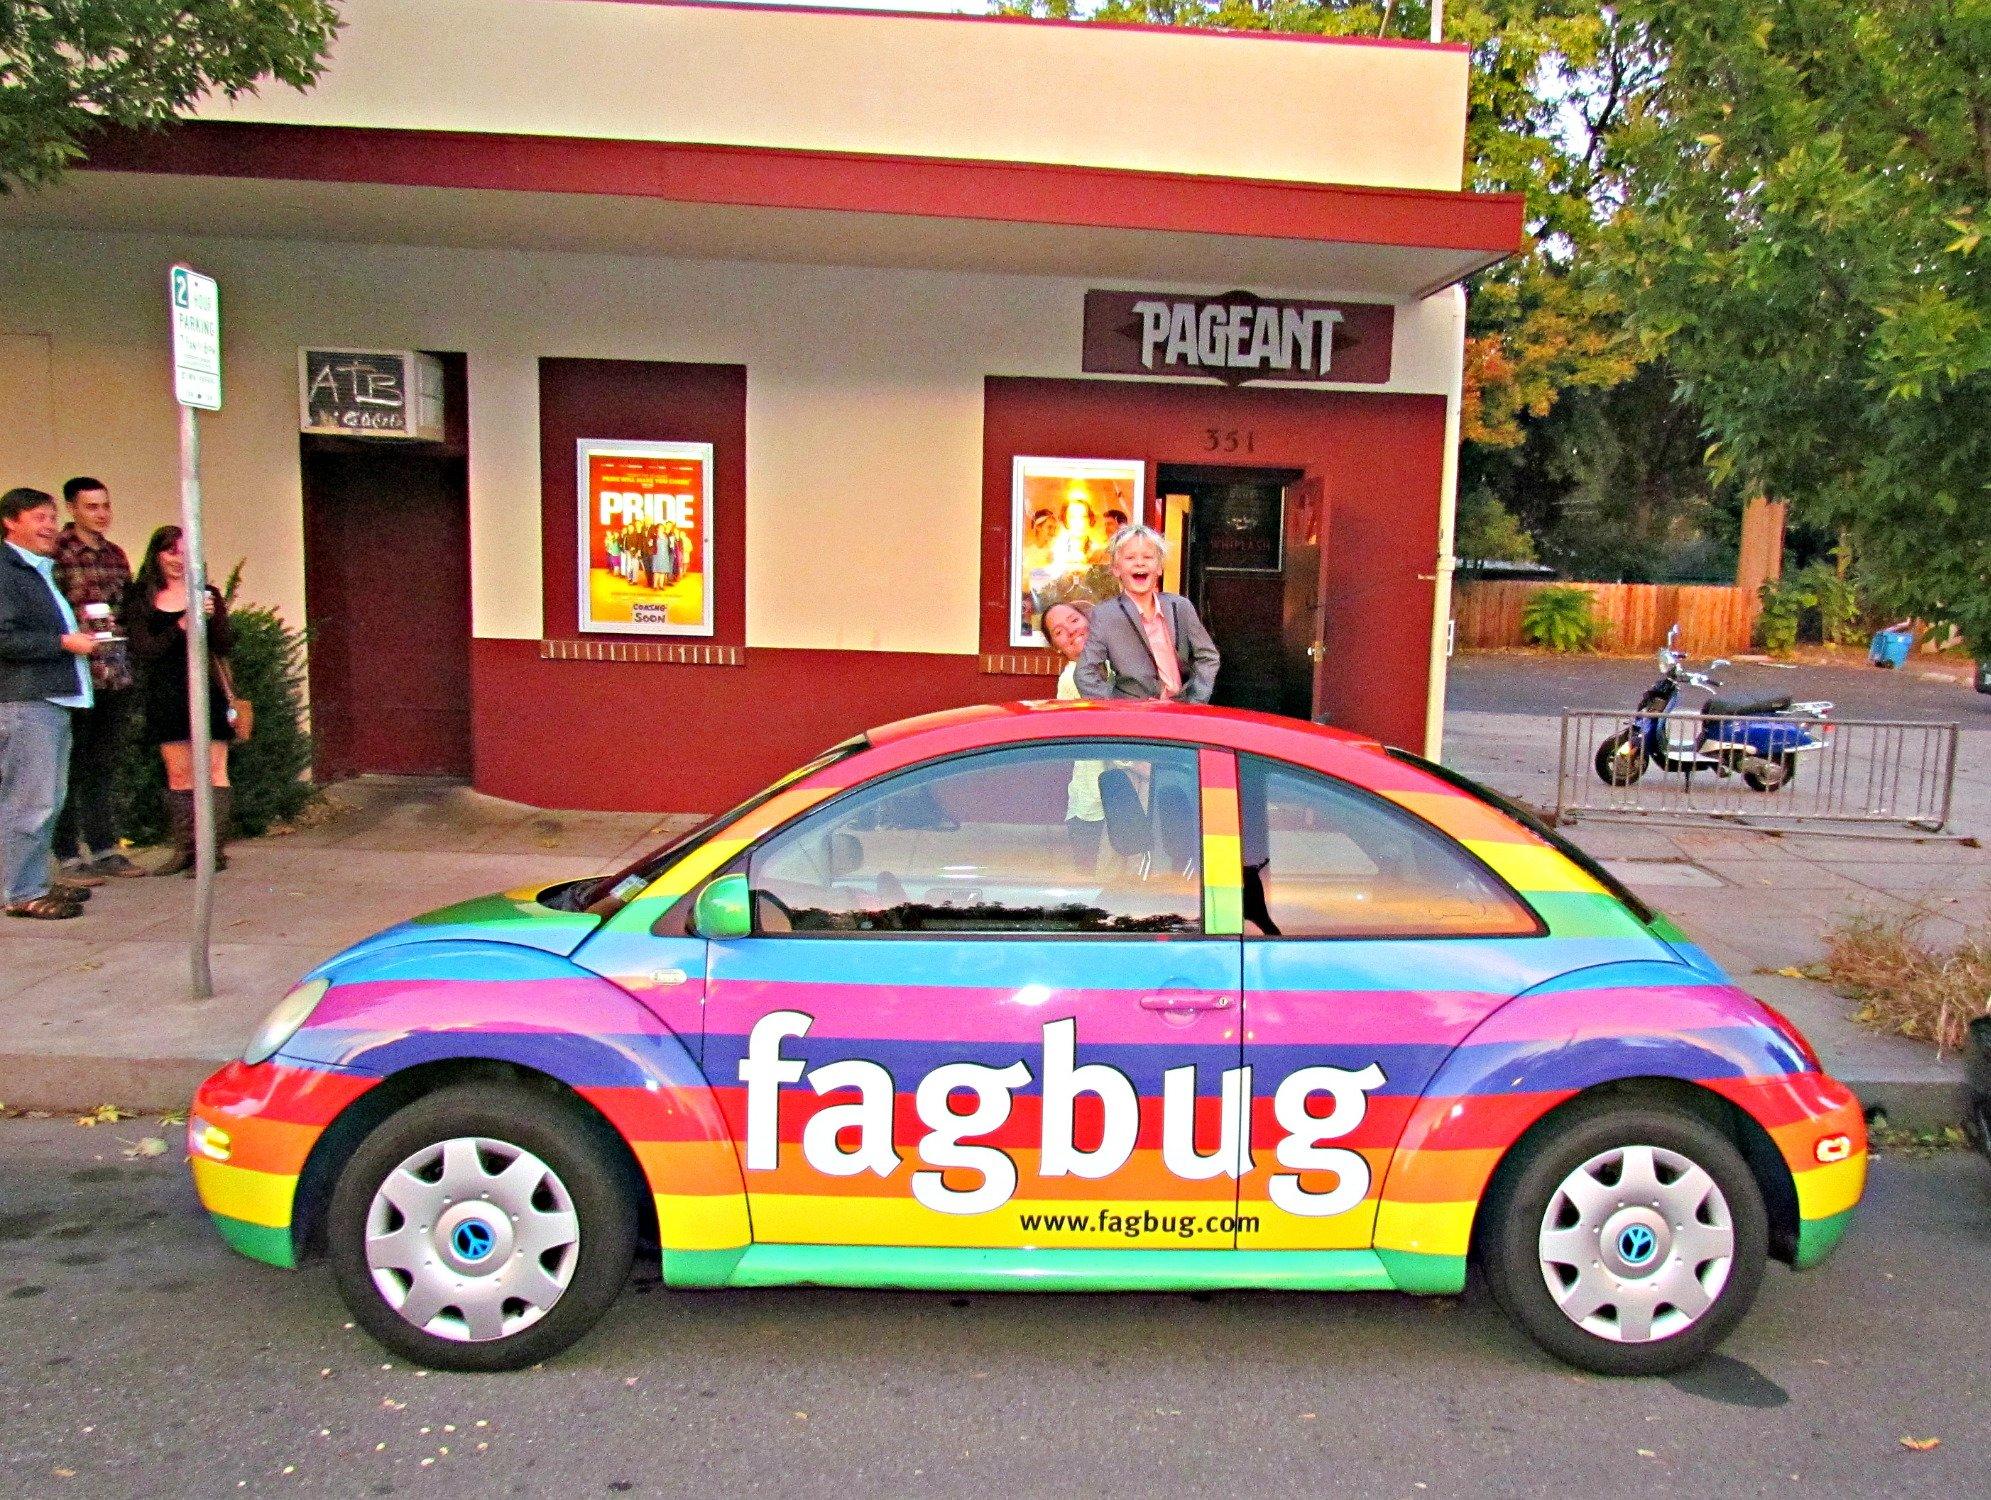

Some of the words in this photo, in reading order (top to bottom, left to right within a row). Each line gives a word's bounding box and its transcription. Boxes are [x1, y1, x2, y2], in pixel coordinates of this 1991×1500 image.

[176, 274, 187, 305] 2
[179, 313, 215, 336] PARKING
[1132, 300, 1344, 376] PAGEANT
[1206, 429, 1255, 453] 351
[600, 491, 694, 528] PRIDE
[634, 612, 666, 624] SOON
[739, 1009, 1387, 1216] fagbug
[1020, 1208, 1260, 1239] www.fagbug.com
